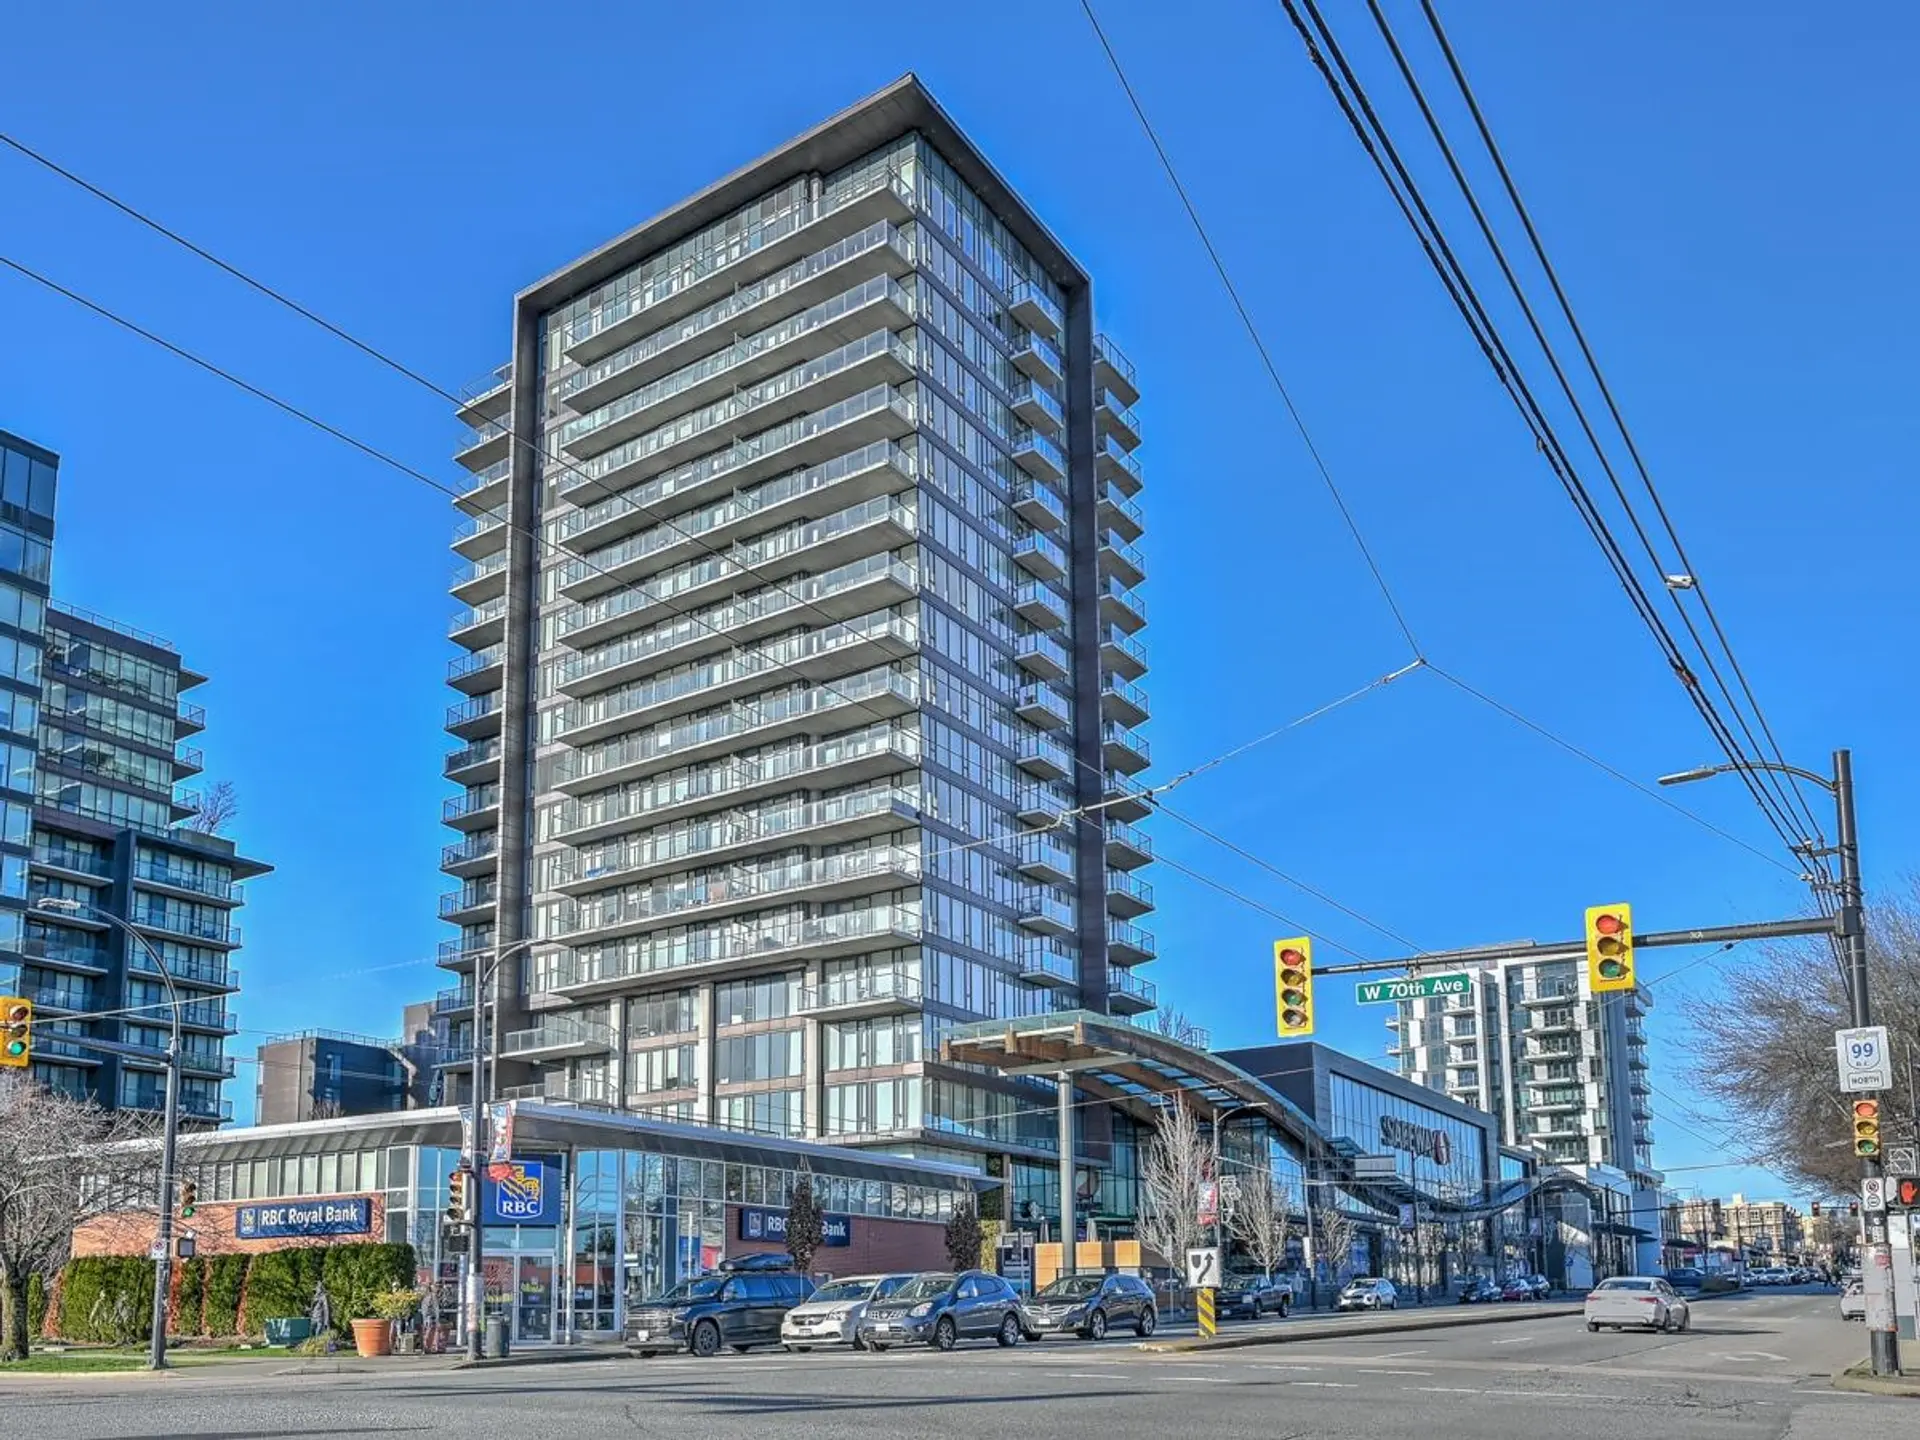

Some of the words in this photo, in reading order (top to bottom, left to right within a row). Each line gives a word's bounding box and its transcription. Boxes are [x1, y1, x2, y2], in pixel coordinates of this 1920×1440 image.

[1363, 985, 1381, 1000] W
[1386, 982, 1425, 998] 70th
[1432, 979, 1463, 994] Ave
[1852, 1042, 1873, 1059] 99
[1851, 1076, 1879, 1085] NORTH
[1380, 1115, 1435, 1157] SAFEWAY
[261, 1208, 286, 1226] RBC
[288, 1206, 323, 1229] Royal
[326, 1203, 358, 1223] Bank
[502, 1200, 538, 1214] RBC
[768, 1216, 789, 1233] RBC
[821, 1220, 846, 1237] Bank
